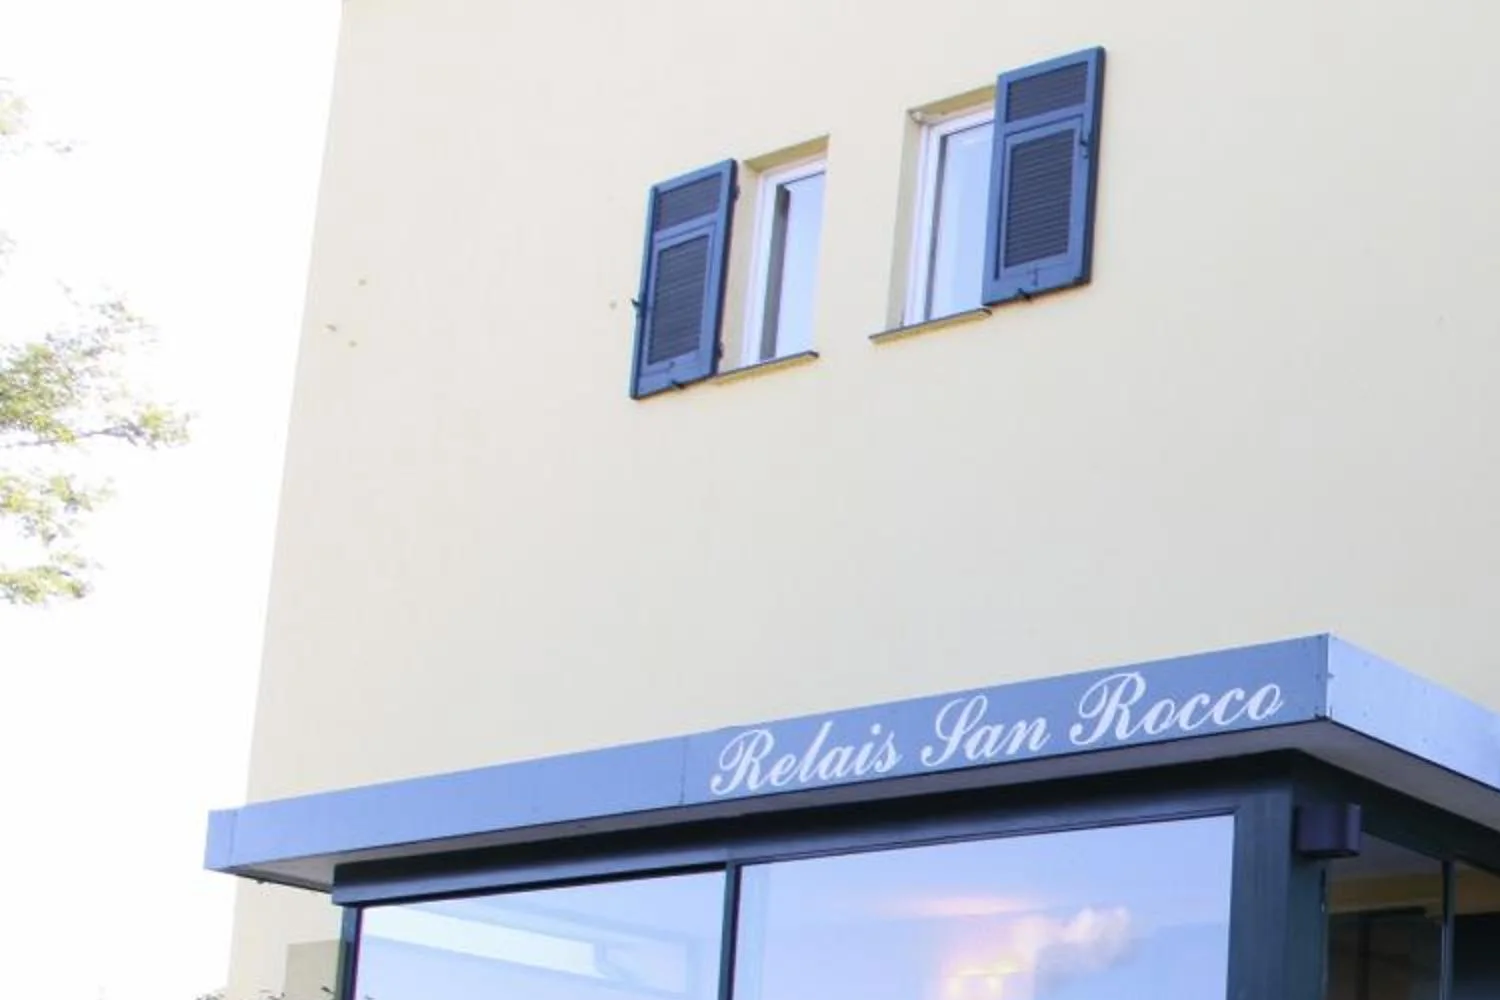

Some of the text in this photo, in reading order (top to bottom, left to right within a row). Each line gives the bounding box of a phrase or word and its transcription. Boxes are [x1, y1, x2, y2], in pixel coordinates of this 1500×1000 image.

[711, 671, 1284, 796] Relais San Rocco
